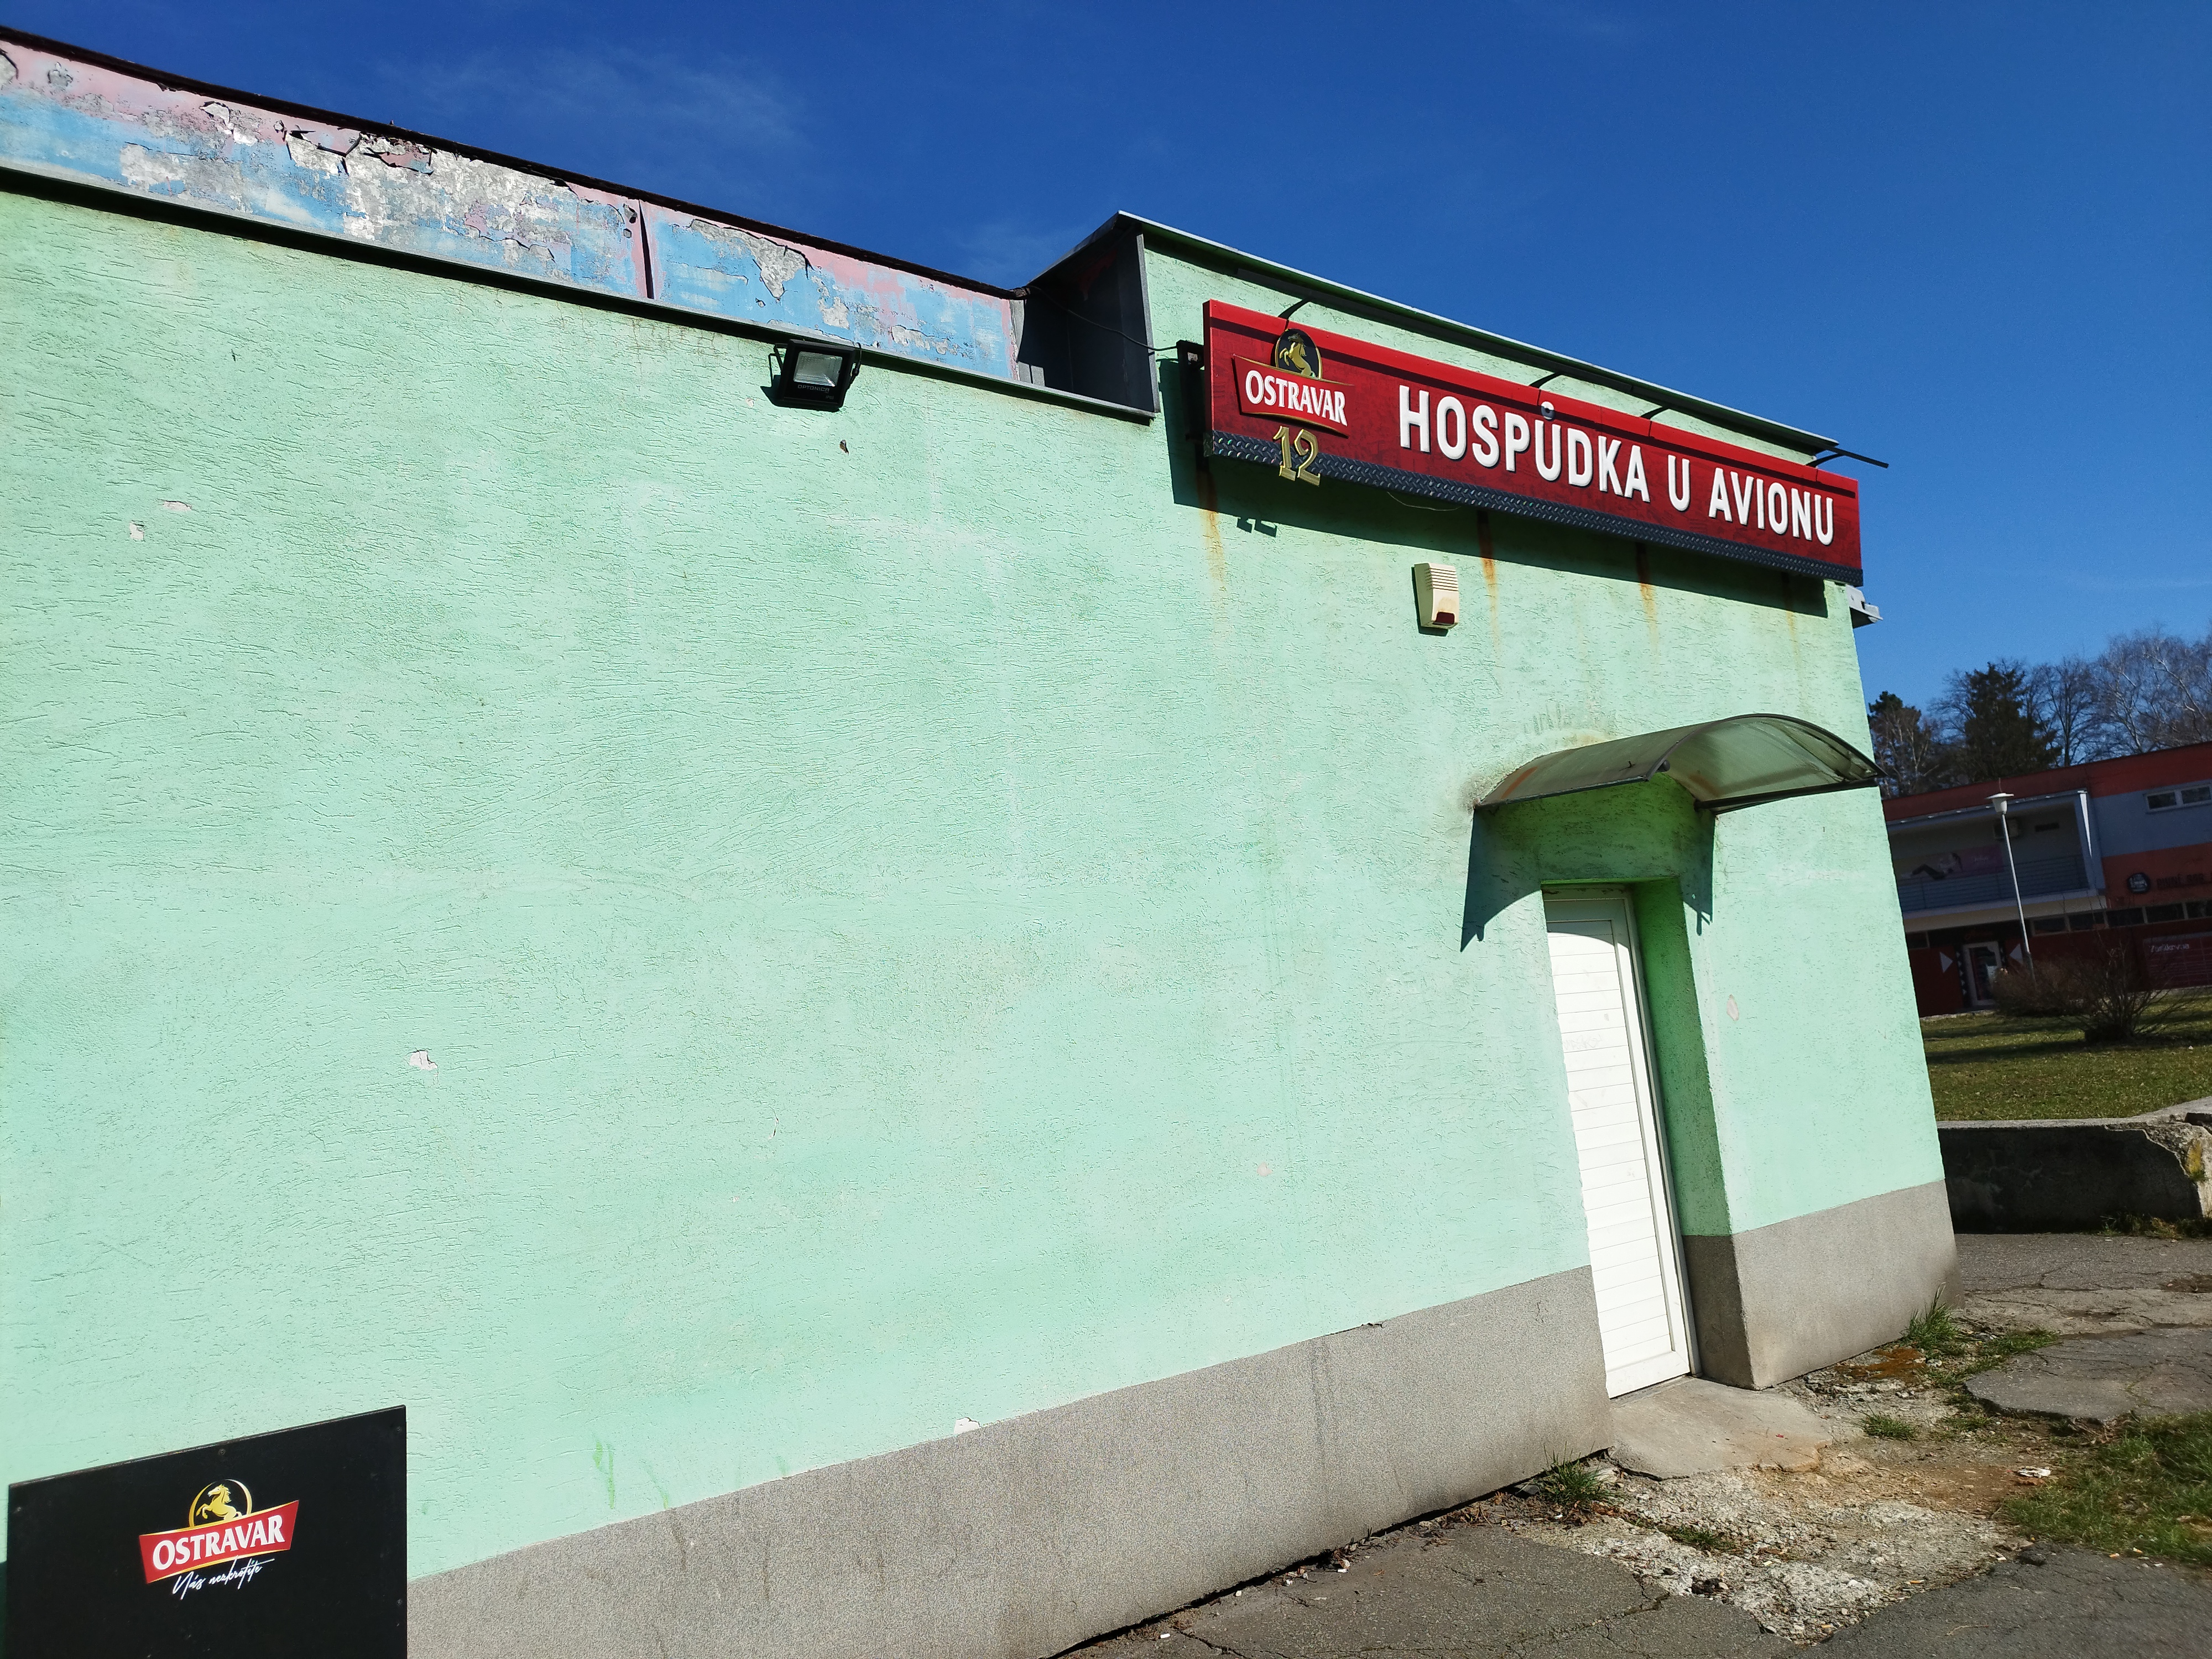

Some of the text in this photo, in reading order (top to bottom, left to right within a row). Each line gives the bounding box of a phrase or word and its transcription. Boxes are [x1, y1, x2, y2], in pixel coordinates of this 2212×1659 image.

[1245, 370, 1348, 427] OSTRAVAR
[1273, 426, 1321, 487] 12
[1399, 385, 1834, 545] HOSPŮDKA U AVIONU
[153, 1515, 285, 1570] OSTRAVAR
[172, 1571, 206, 1600] Nás
